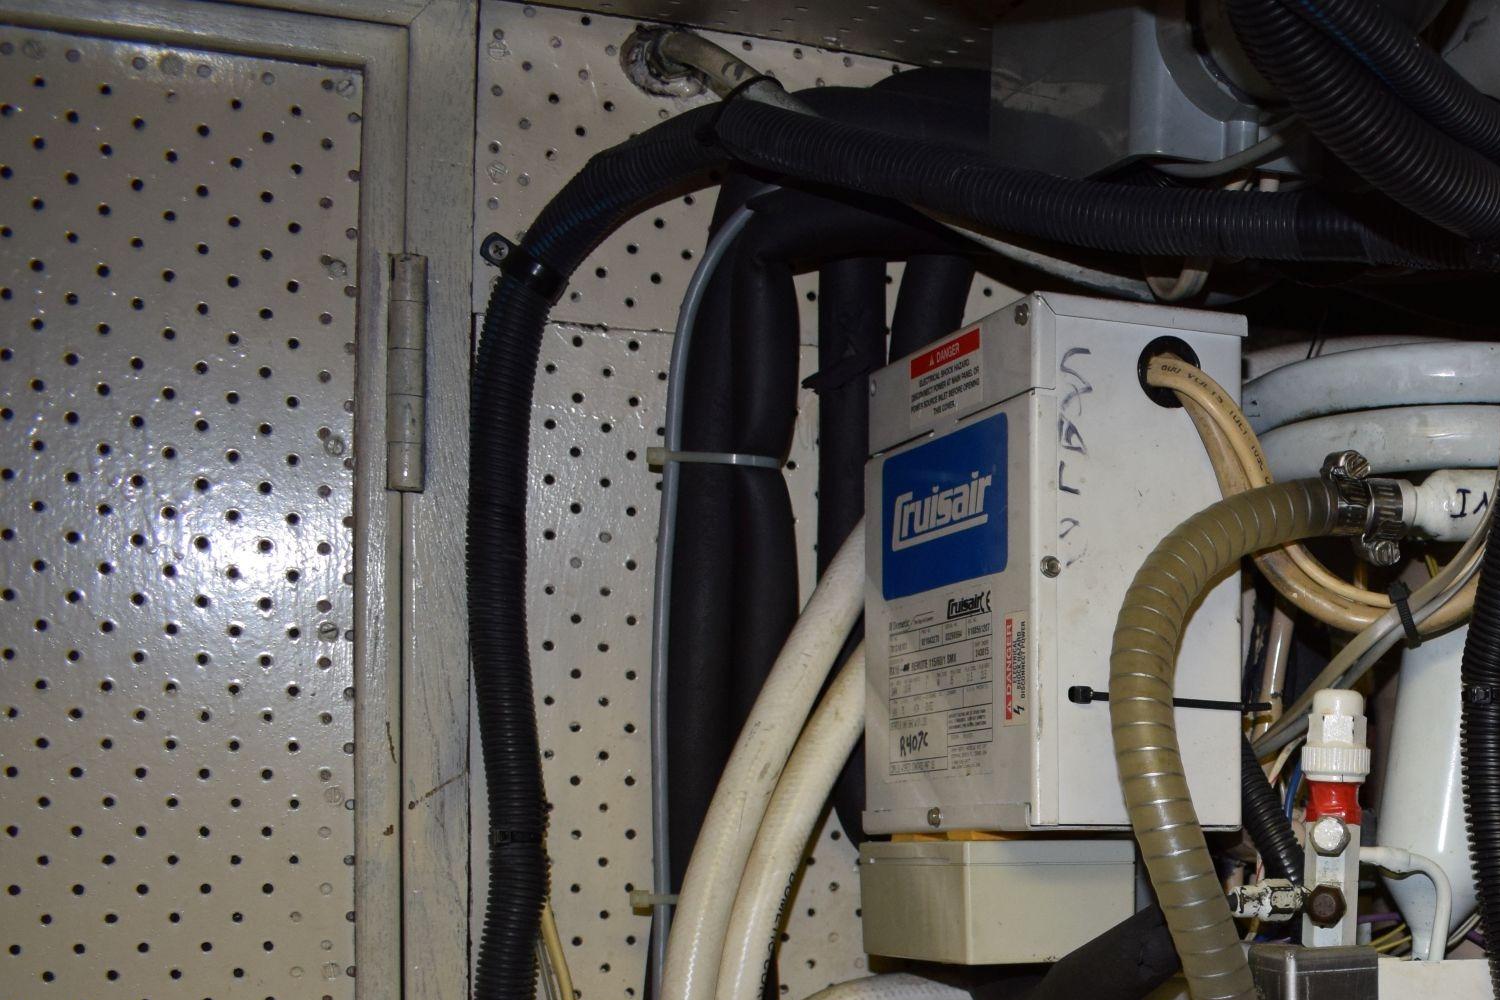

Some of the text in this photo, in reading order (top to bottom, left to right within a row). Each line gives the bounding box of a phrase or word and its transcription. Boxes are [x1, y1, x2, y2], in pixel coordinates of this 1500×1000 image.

[936, 342, 960, 363] DANGER
[892, 470, 992, 552] Cruisair
[947, 592, 984, 619] Cruisair
[899, 729, 929, 757] R407C
